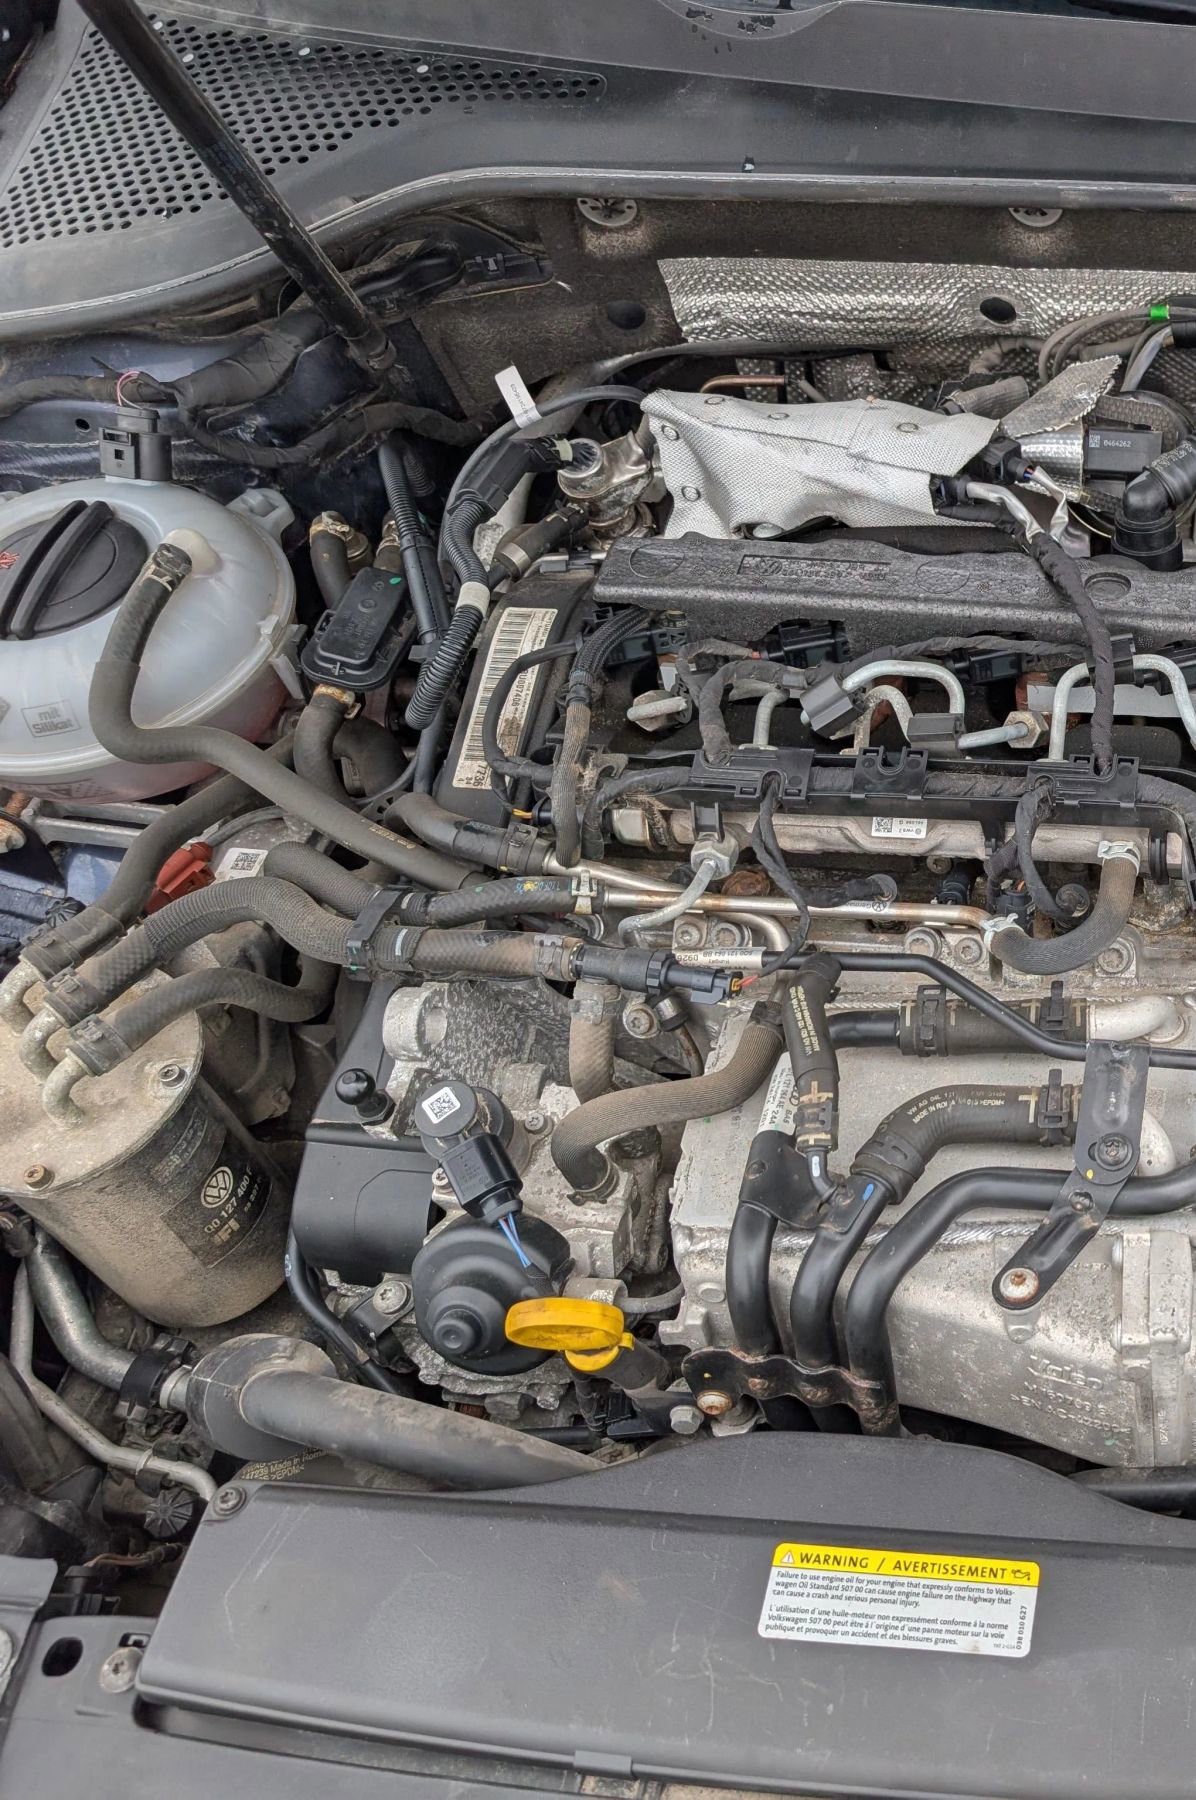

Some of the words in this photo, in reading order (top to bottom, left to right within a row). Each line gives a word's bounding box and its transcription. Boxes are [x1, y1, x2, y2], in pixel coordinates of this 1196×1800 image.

[38, 707, 61, 721] mit
[32, 719, 73, 734] Silikat
[912, 1110, 929, 1124] MADE
[220, 1196, 238, 1219] 127
[237, 1174, 250, 1198] 400
[798, 1551, 868, 1568] WARNING
[892, 1559, 1006, 1580] AVERTISSEMENT
[821, 1574, 844, 1584] engine
[882, 1579, 905, 1589] engine
[921, 1582, 952, 1592] expressly
[954, 1585, 984, 1593] conforms
[809, 1582, 839, 1590] Standard
[897, 1589, 920, 1599] engine
[967, 1594, 995, 1605] highway
[869, 1596, 897, 1606] personal
[899, 1598, 920, 1608] injury.
[767, 1614, 807, 1625] Volkswagen
[832, 1619, 848, 1628] peut
[921, 1627, 942, 1635] panne
[944, 1627, 969, 1635] moteur
[832, 1609, 875, 1619] huile-moteur
[939, 1617, 971, 1626] conforme
[764, 1623, 795, 1633] publique
[804, 1628, 838, 1636] provoquer
[850, 1629, 878, 1638] accident
[902, 1633, 932, 1642] blessures
[934, 1638, 957, 1646] graves.
